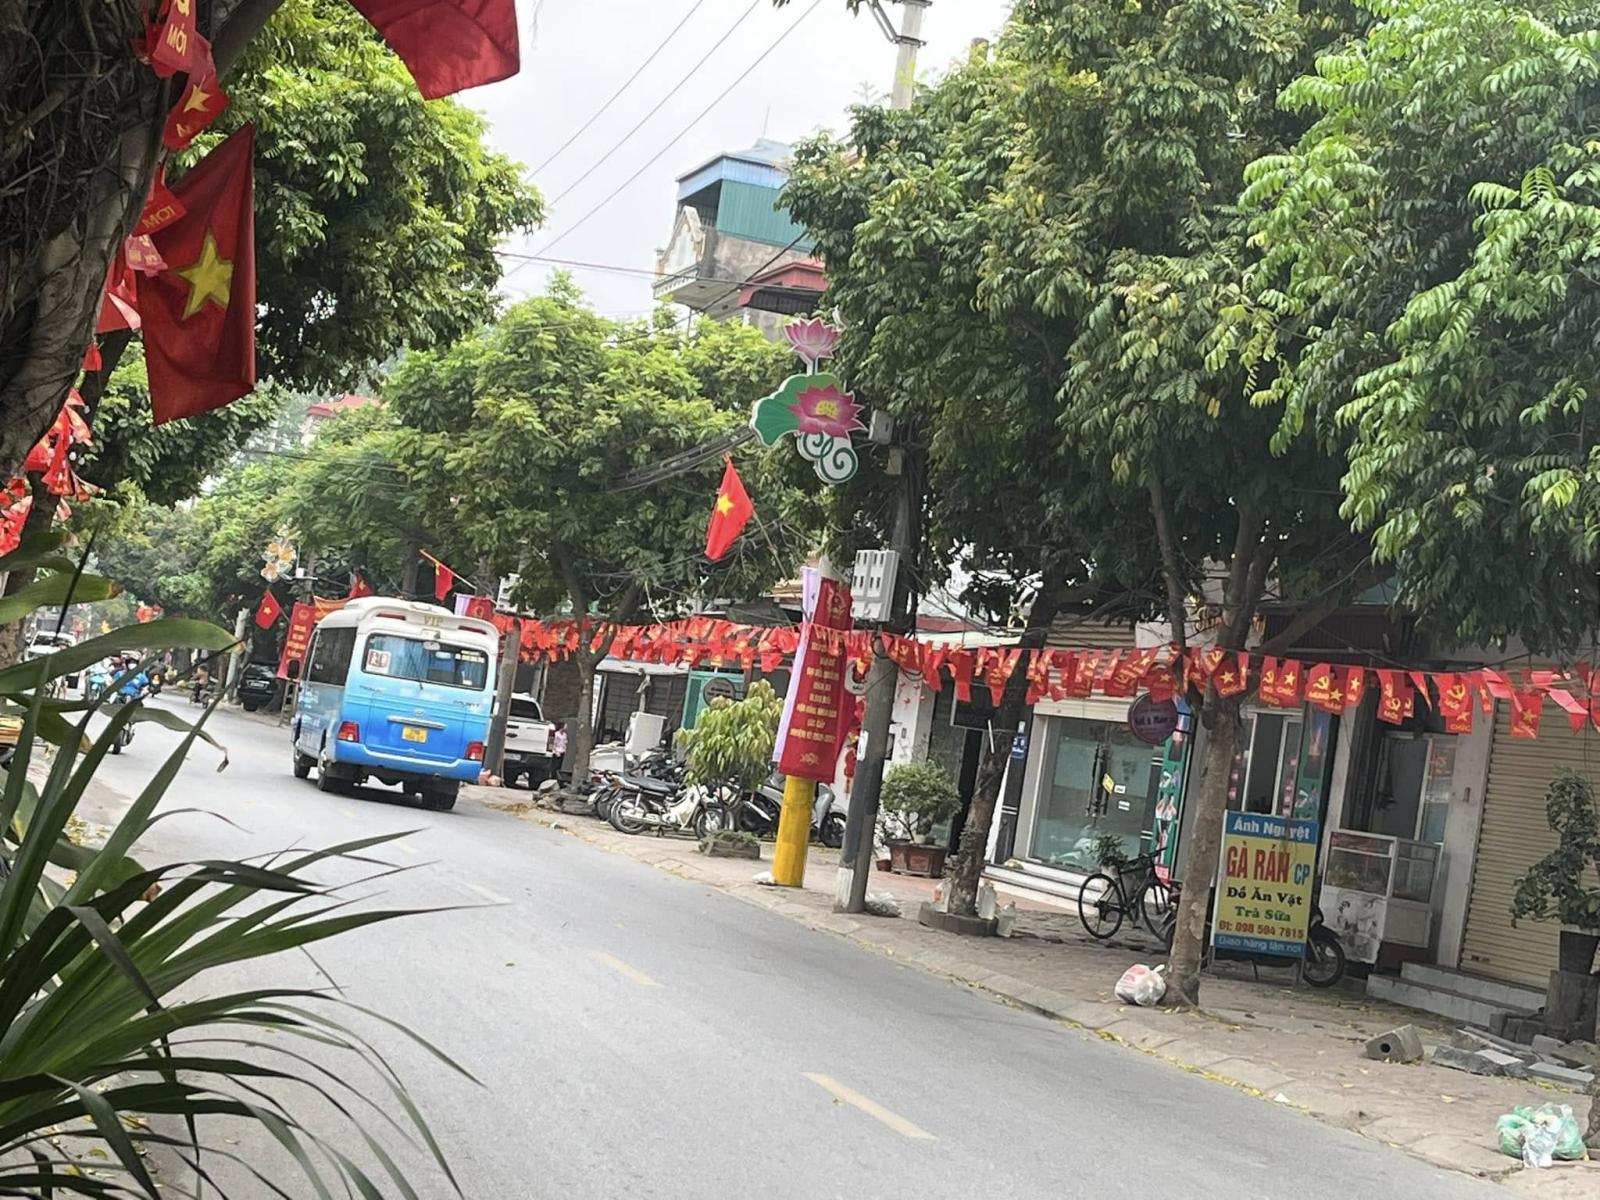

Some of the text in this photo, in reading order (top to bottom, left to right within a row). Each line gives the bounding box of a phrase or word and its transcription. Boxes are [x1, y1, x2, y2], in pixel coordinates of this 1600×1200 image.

[1226, 840, 1311, 885] GÀ RÁN CP
[1251, 887, 1272, 901] Ăn
